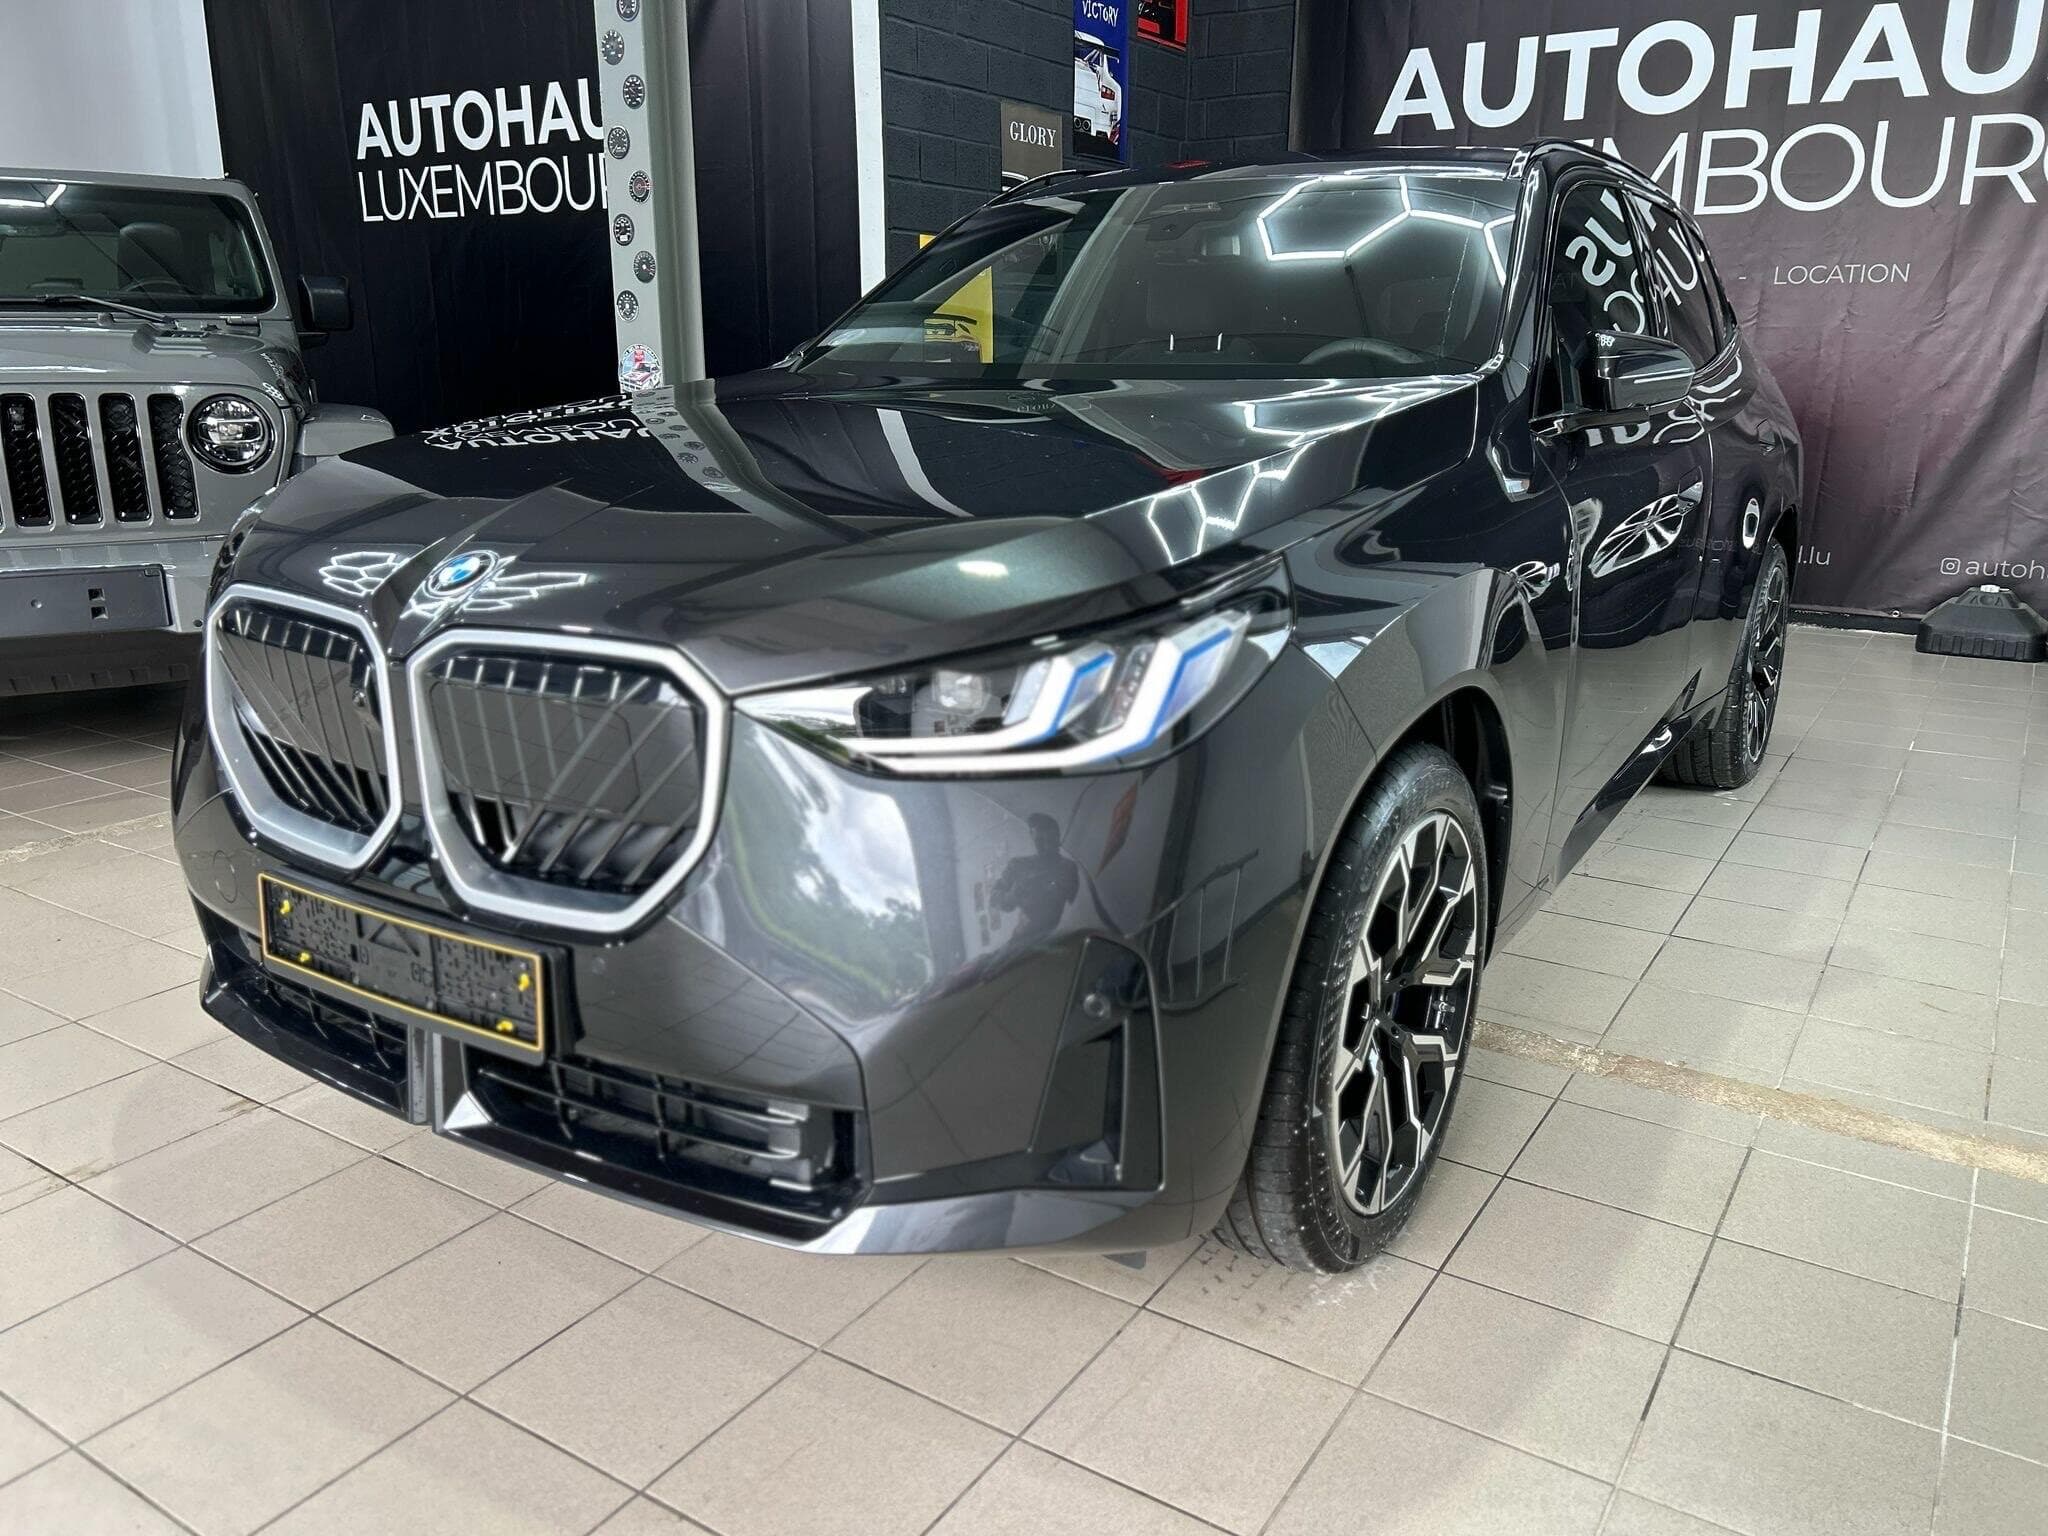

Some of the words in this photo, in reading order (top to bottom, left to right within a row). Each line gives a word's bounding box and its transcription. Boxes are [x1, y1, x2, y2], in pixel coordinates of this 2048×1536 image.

[1082, 0, 1119, 27] VICTORY
[1374, 0, 2048, 135] AUTOHAU
[357, 78, 604, 160] AUTOHAU
[1010, 121, 1057, 148] GLORY
[358, 152, 607, 222] LUXEMBOU
[1575, 113, 2048, 216] MBOUR
[1773, 263, 1911, 285] LOCATION
[1965, 560, 2048, 579] autoh
